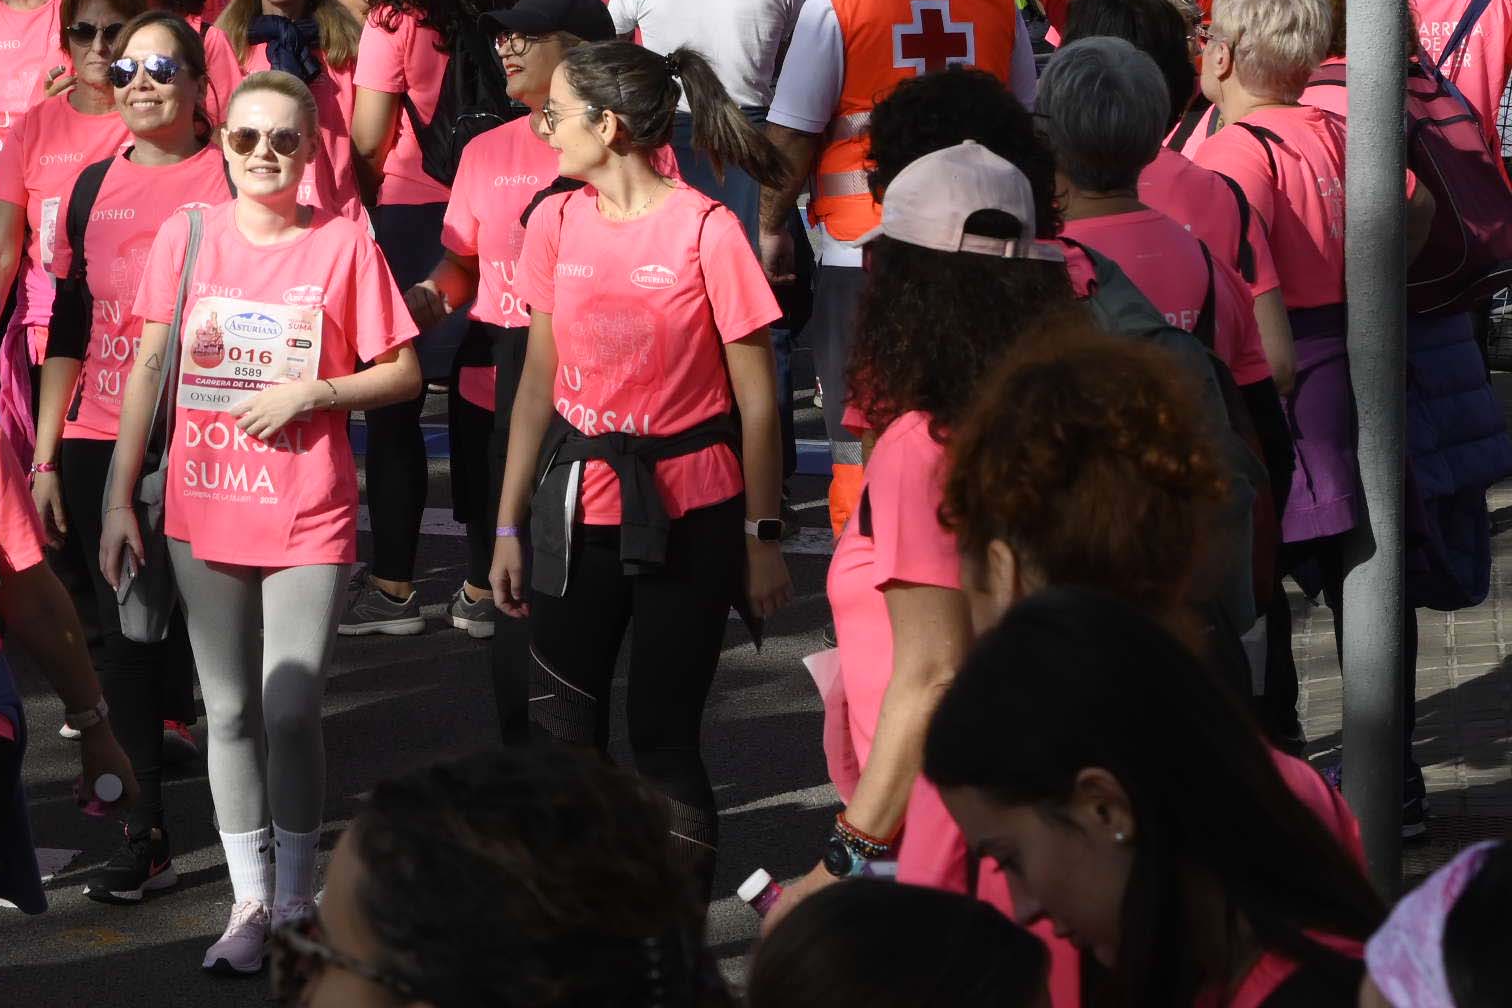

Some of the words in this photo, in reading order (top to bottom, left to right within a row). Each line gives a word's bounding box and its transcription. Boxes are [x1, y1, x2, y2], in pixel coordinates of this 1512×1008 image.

[39, 152, 84, 166] OYSHO
[494, 175, 538, 187] OYSHO
[90, 207, 135, 221] OYSHO
[556, 263, 594, 279] OYSHO
[229, 320, 278, 335] ASTURIANA
[228, 346, 273, 365] 016
[234, 366, 262, 378] 8589
[195, 377, 231, 386] CARRERA
[233, 380, 244, 388] DE
[190, 391, 230, 404] OYSHO
[184, 459, 275, 493] SUMA
